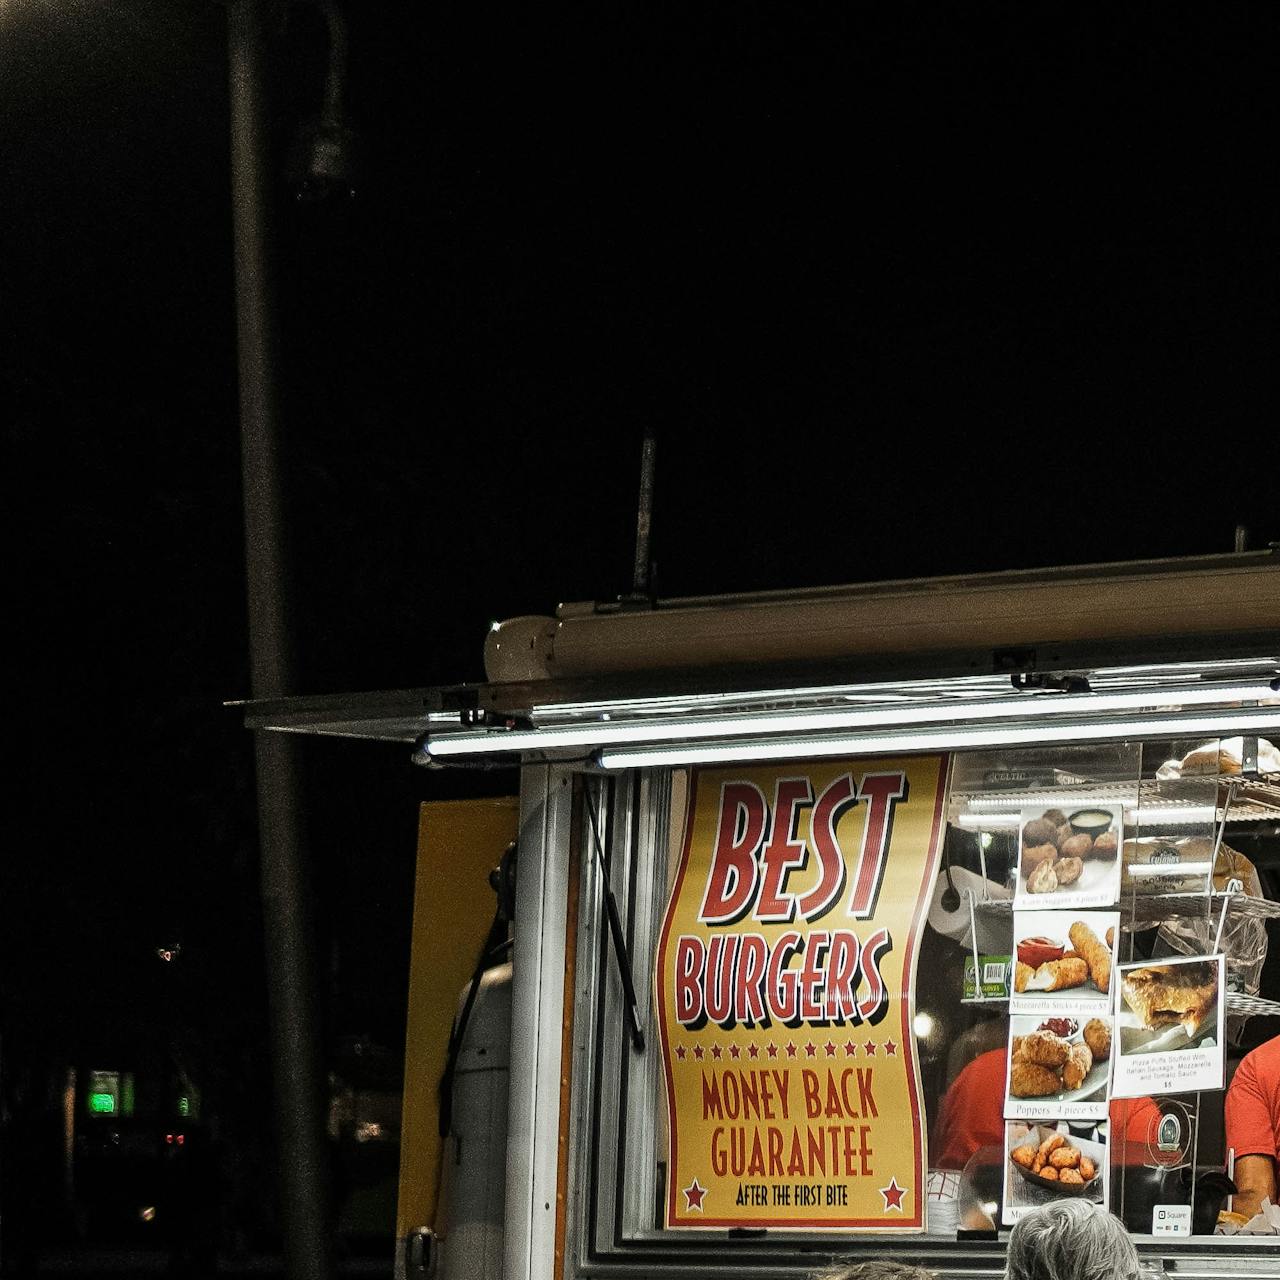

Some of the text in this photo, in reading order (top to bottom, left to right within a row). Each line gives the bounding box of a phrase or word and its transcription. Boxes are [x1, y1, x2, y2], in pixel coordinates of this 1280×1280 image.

[698, 771, 908, 924] BEST
[674, 927, 894, 1030] BURGERS
[702, 1067, 878, 1120] MONEY BACK
[1016, 1105, 1050, 1116] Poppers
[1064, 1106, 1086, 1115] piece
[711, 1125, 873, 1178] GUARANTEE
[735, 1183, 848, 1207] AFTER THE FIRST BITE
